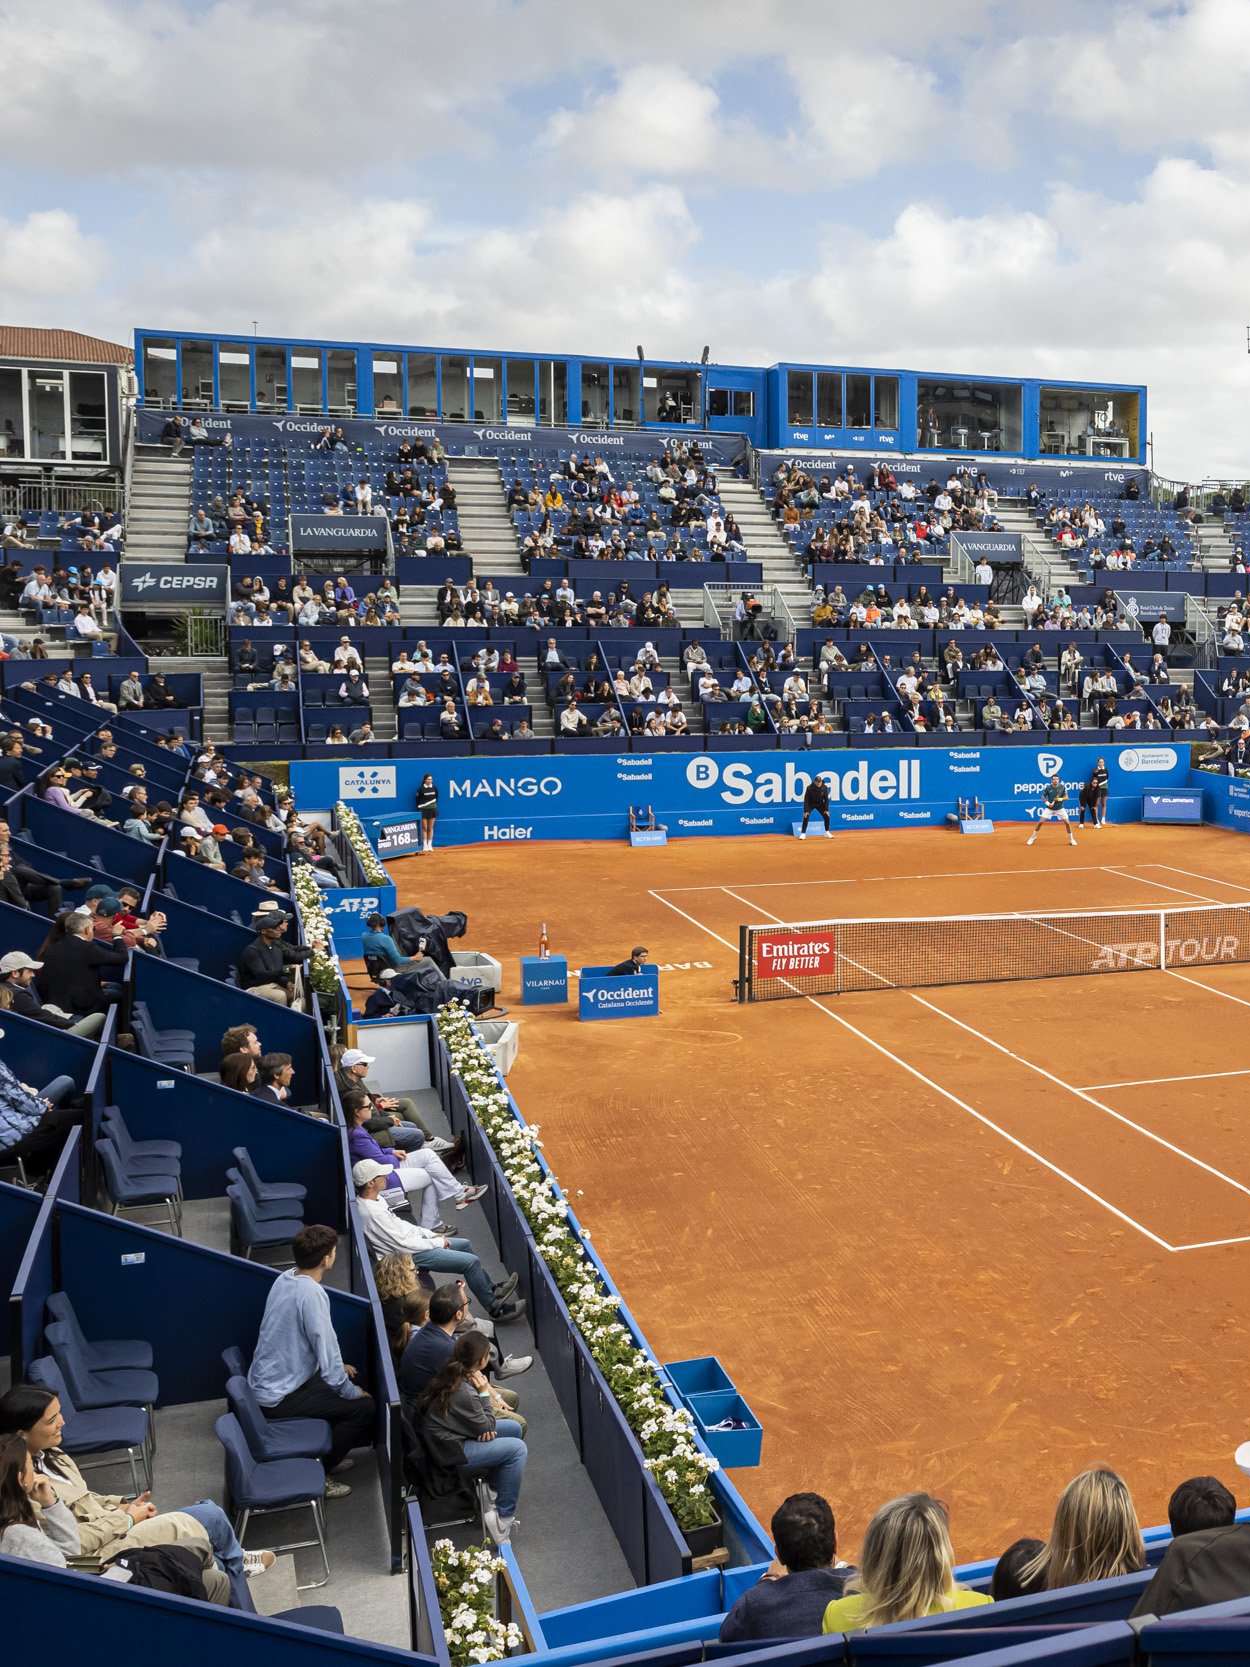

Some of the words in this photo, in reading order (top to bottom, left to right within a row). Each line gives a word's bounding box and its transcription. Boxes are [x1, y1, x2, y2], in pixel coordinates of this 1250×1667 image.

[286, 421, 336, 434] Occident
[388, 425, 436, 438] Occident
[486, 429, 532, 441] Occident
[580, 433, 624, 446] Occident
[793, 432, 809, 441] rtve
[879, 434, 895, 444] rtve
[796, 459, 837, 470] Occident
[956, 464, 978, 477] rtve
[1104, 471, 1125, 484] rtve
[300, 527, 312, 536] LA
[312, 527, 378, 537] VANGUARDIA
[967, 543, 1017, 552] VANGUARDIA
[159, 576, 218, 589] CEPSA
[622, 758, 653, 766] Sabadell
[954, 765, 981, 773] Sabadell
[622, 773, 653, 781] Sabadell
[449, 776, 562, 798] MANGO
[745, 816, 774, 825] Sabadell
[846, 813, 874, 821] Sabadell
[903, 811, 931, 819] Sabadell
[683, 819, 713, 827] Sabadell
[484, 824, 533, 840] Haier
[392, 833, 411, 847] 168
[333, 897, 379, 913] ATP
[761, 941, 830, 958] Emirates
[1088, 941, 1159, 969] ATP
[1165, 935, 1240, 963] TOUR
[772, 958, 787, 971] FLY
[789, 956, 820, 970] BETTER
[526, 978, 566, 988] VILARNAU
[598, 987, 653, 1001] Occident
[598, 1001, 625, 1009] Catalana
[625, 999, 654, 1007] Occidente
